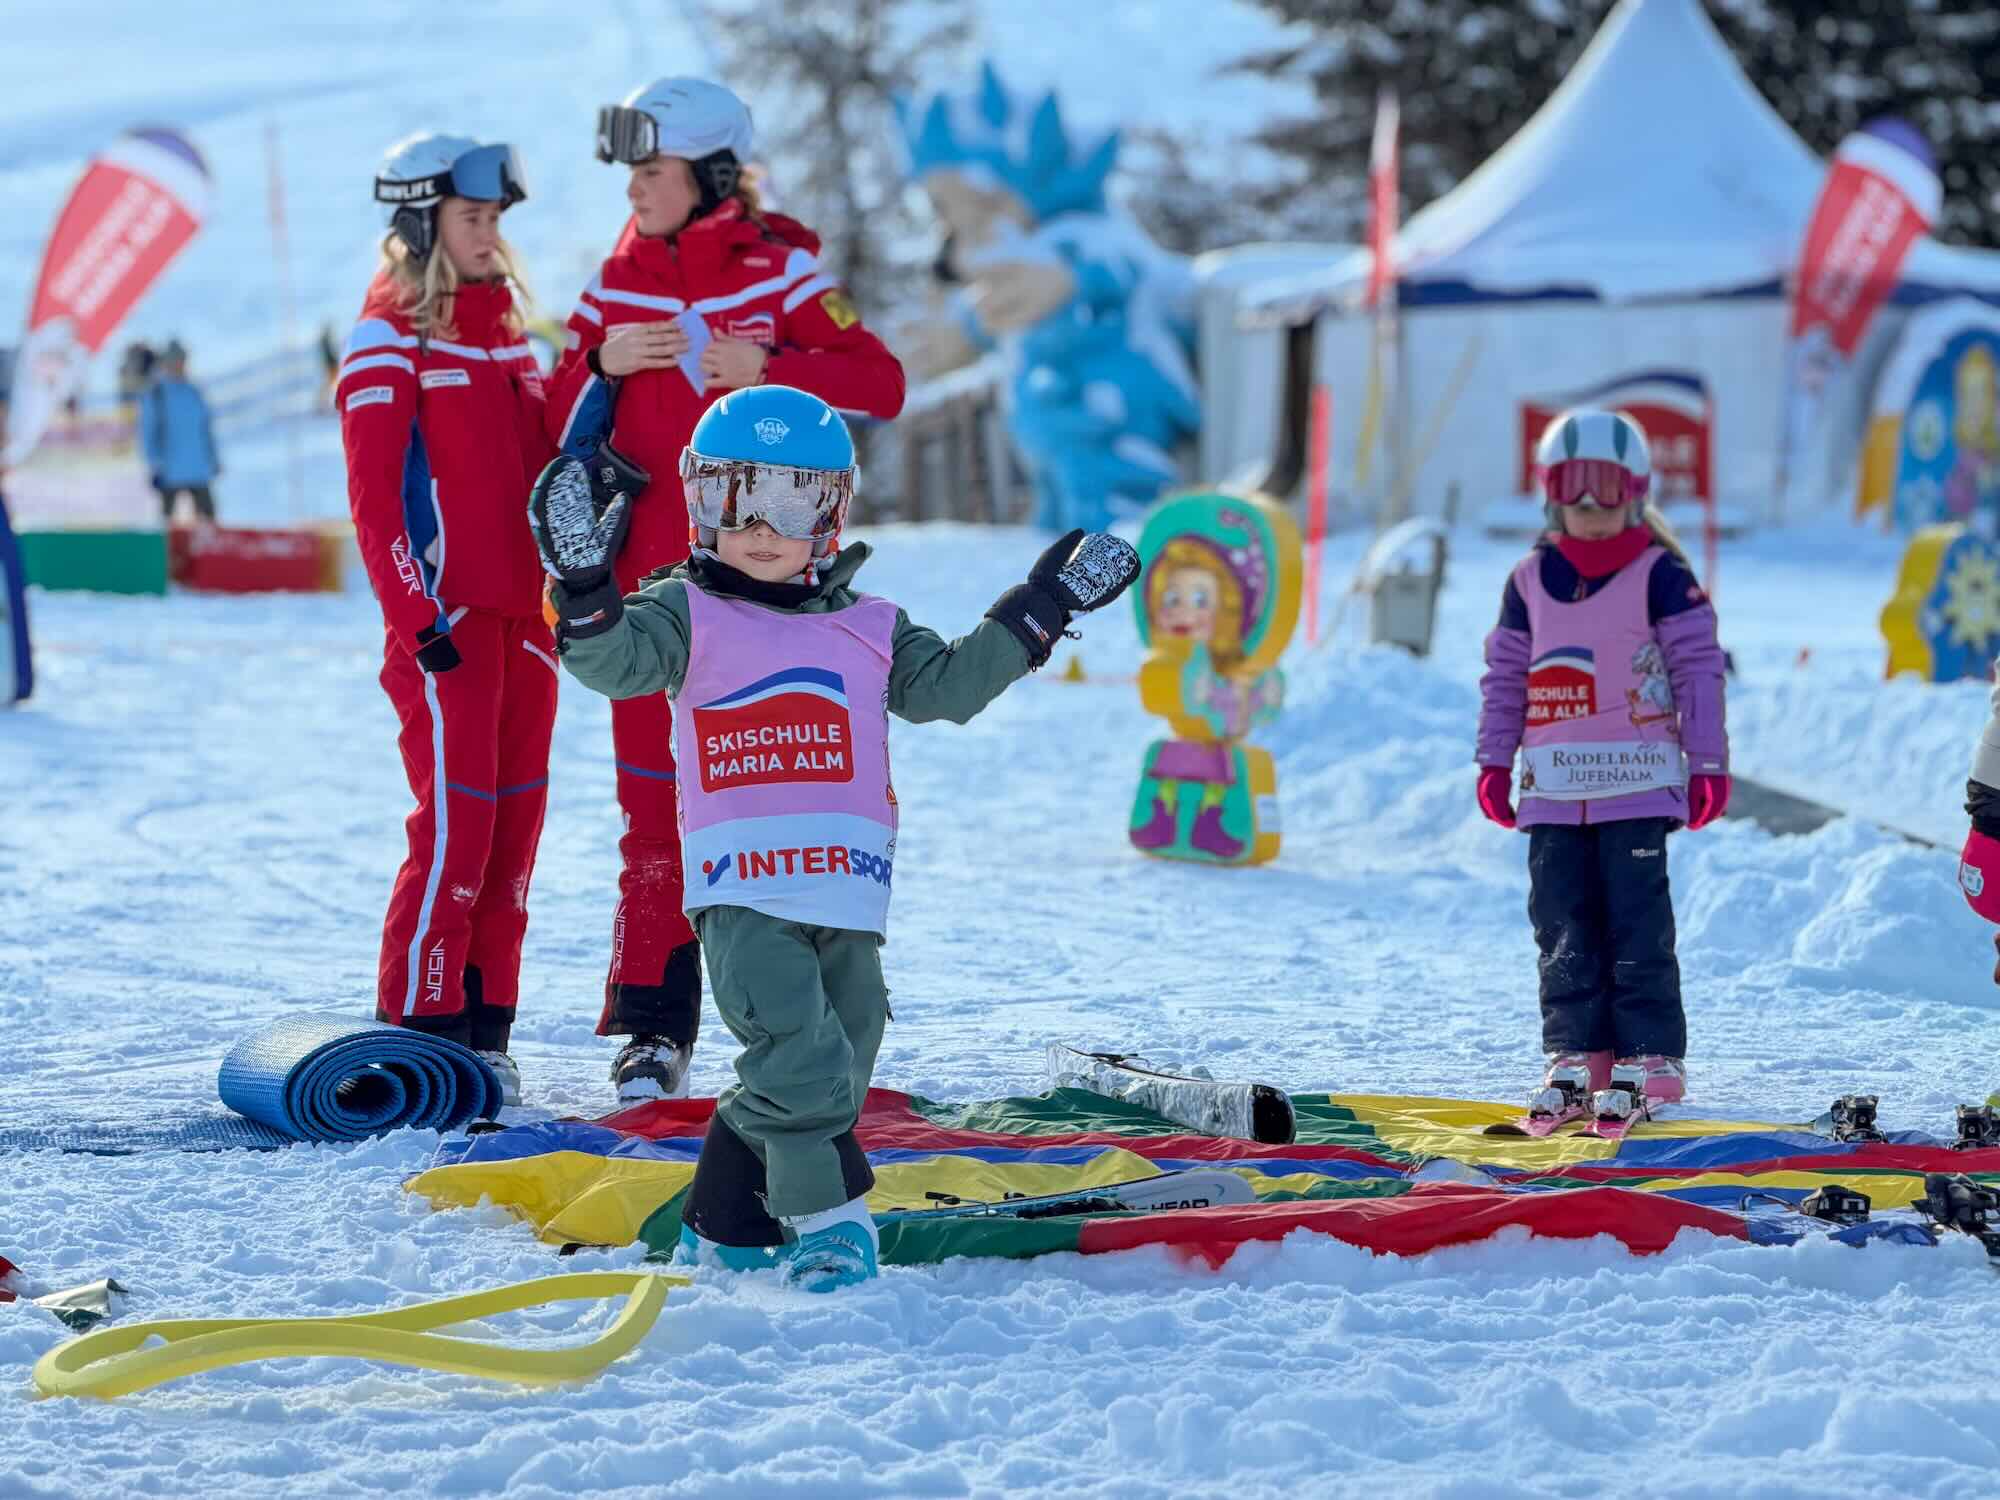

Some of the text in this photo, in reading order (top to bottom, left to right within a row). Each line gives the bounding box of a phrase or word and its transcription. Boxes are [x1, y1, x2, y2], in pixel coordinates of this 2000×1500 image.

[390, 535, 421, 596] VISOR
[1553, 703, 1589, 720] ALM
[706, 724, 842, 756] SKISCHULE
[709, 751, 844, 781] MARIA ALM
[737, 846, 893, 888] INTERSPOR
[425, 937, 445, 1002] VISOR
